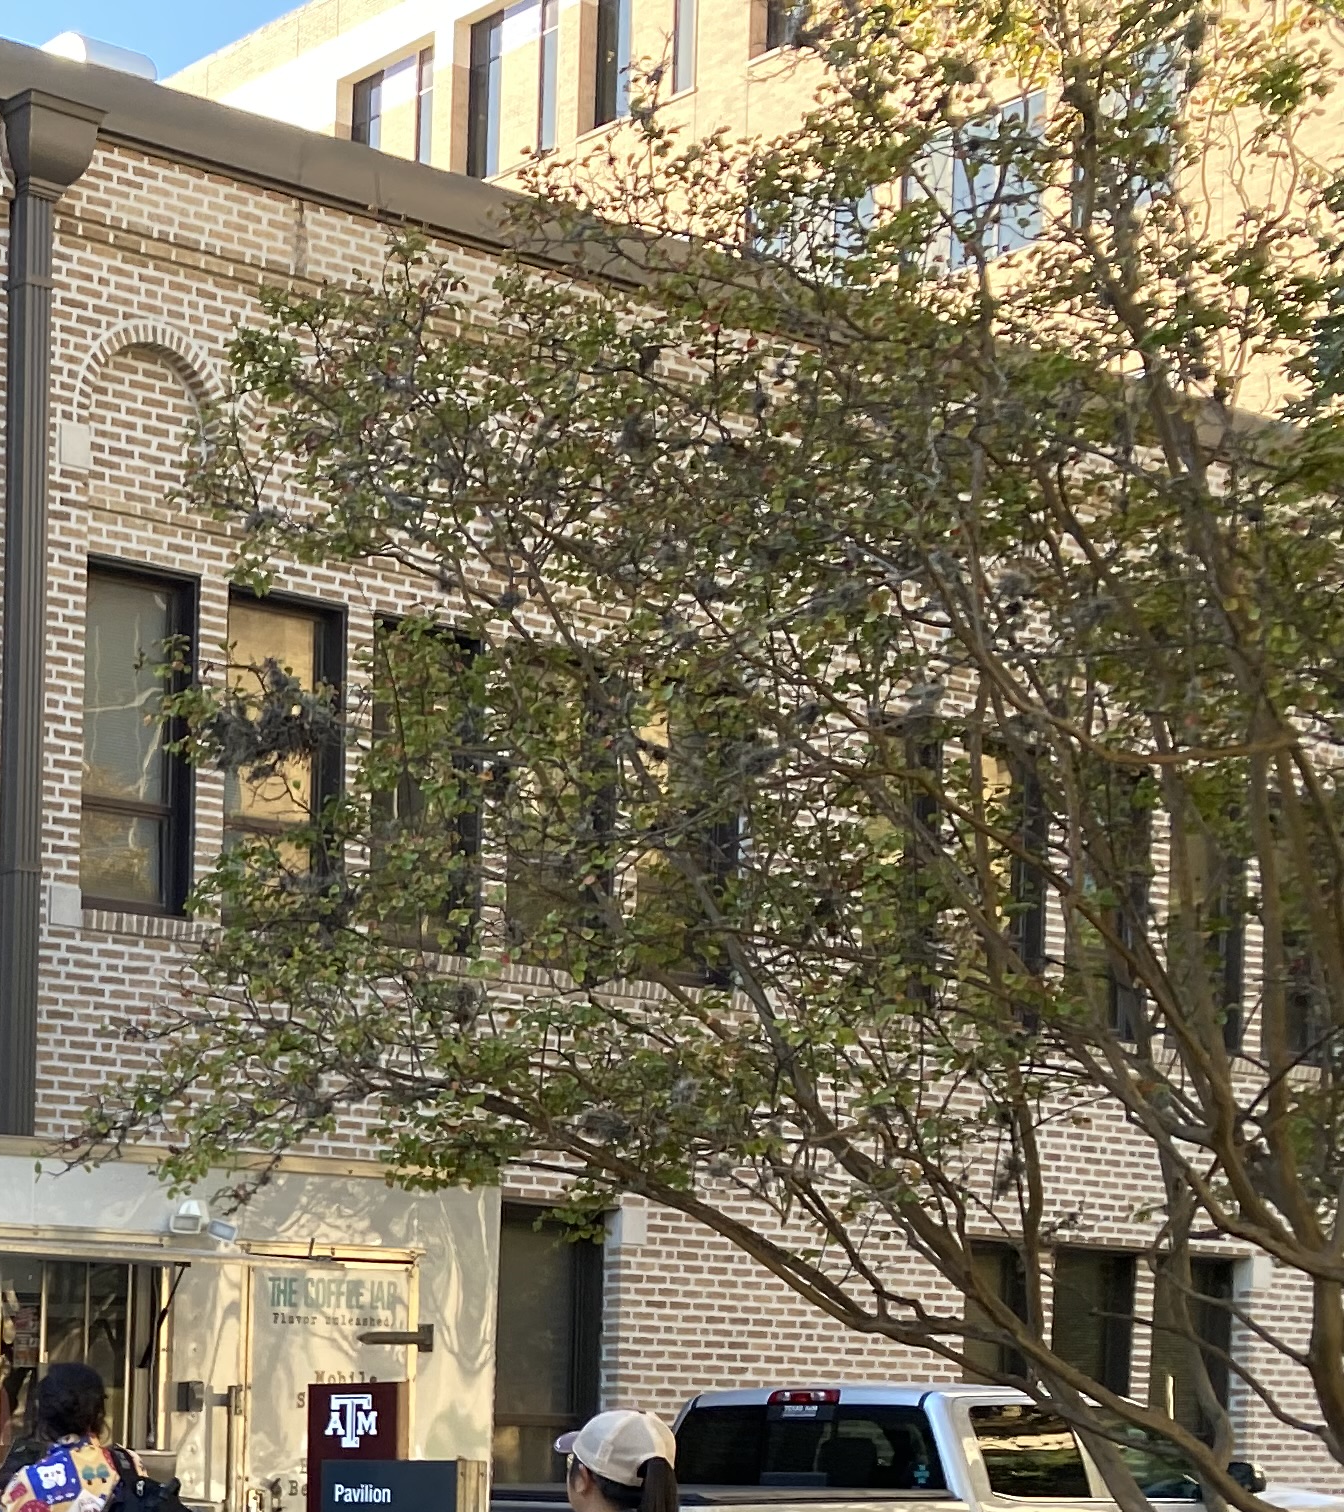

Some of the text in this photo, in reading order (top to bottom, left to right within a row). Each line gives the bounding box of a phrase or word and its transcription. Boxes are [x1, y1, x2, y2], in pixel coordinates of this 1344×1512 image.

[268, 1277, 298, 1307] THE
[304, 1278, 364, 1309] COFFEE
[273, 1312, 317, 1324] Flavor
[334, 1483, 391, 1503] Pavilion
